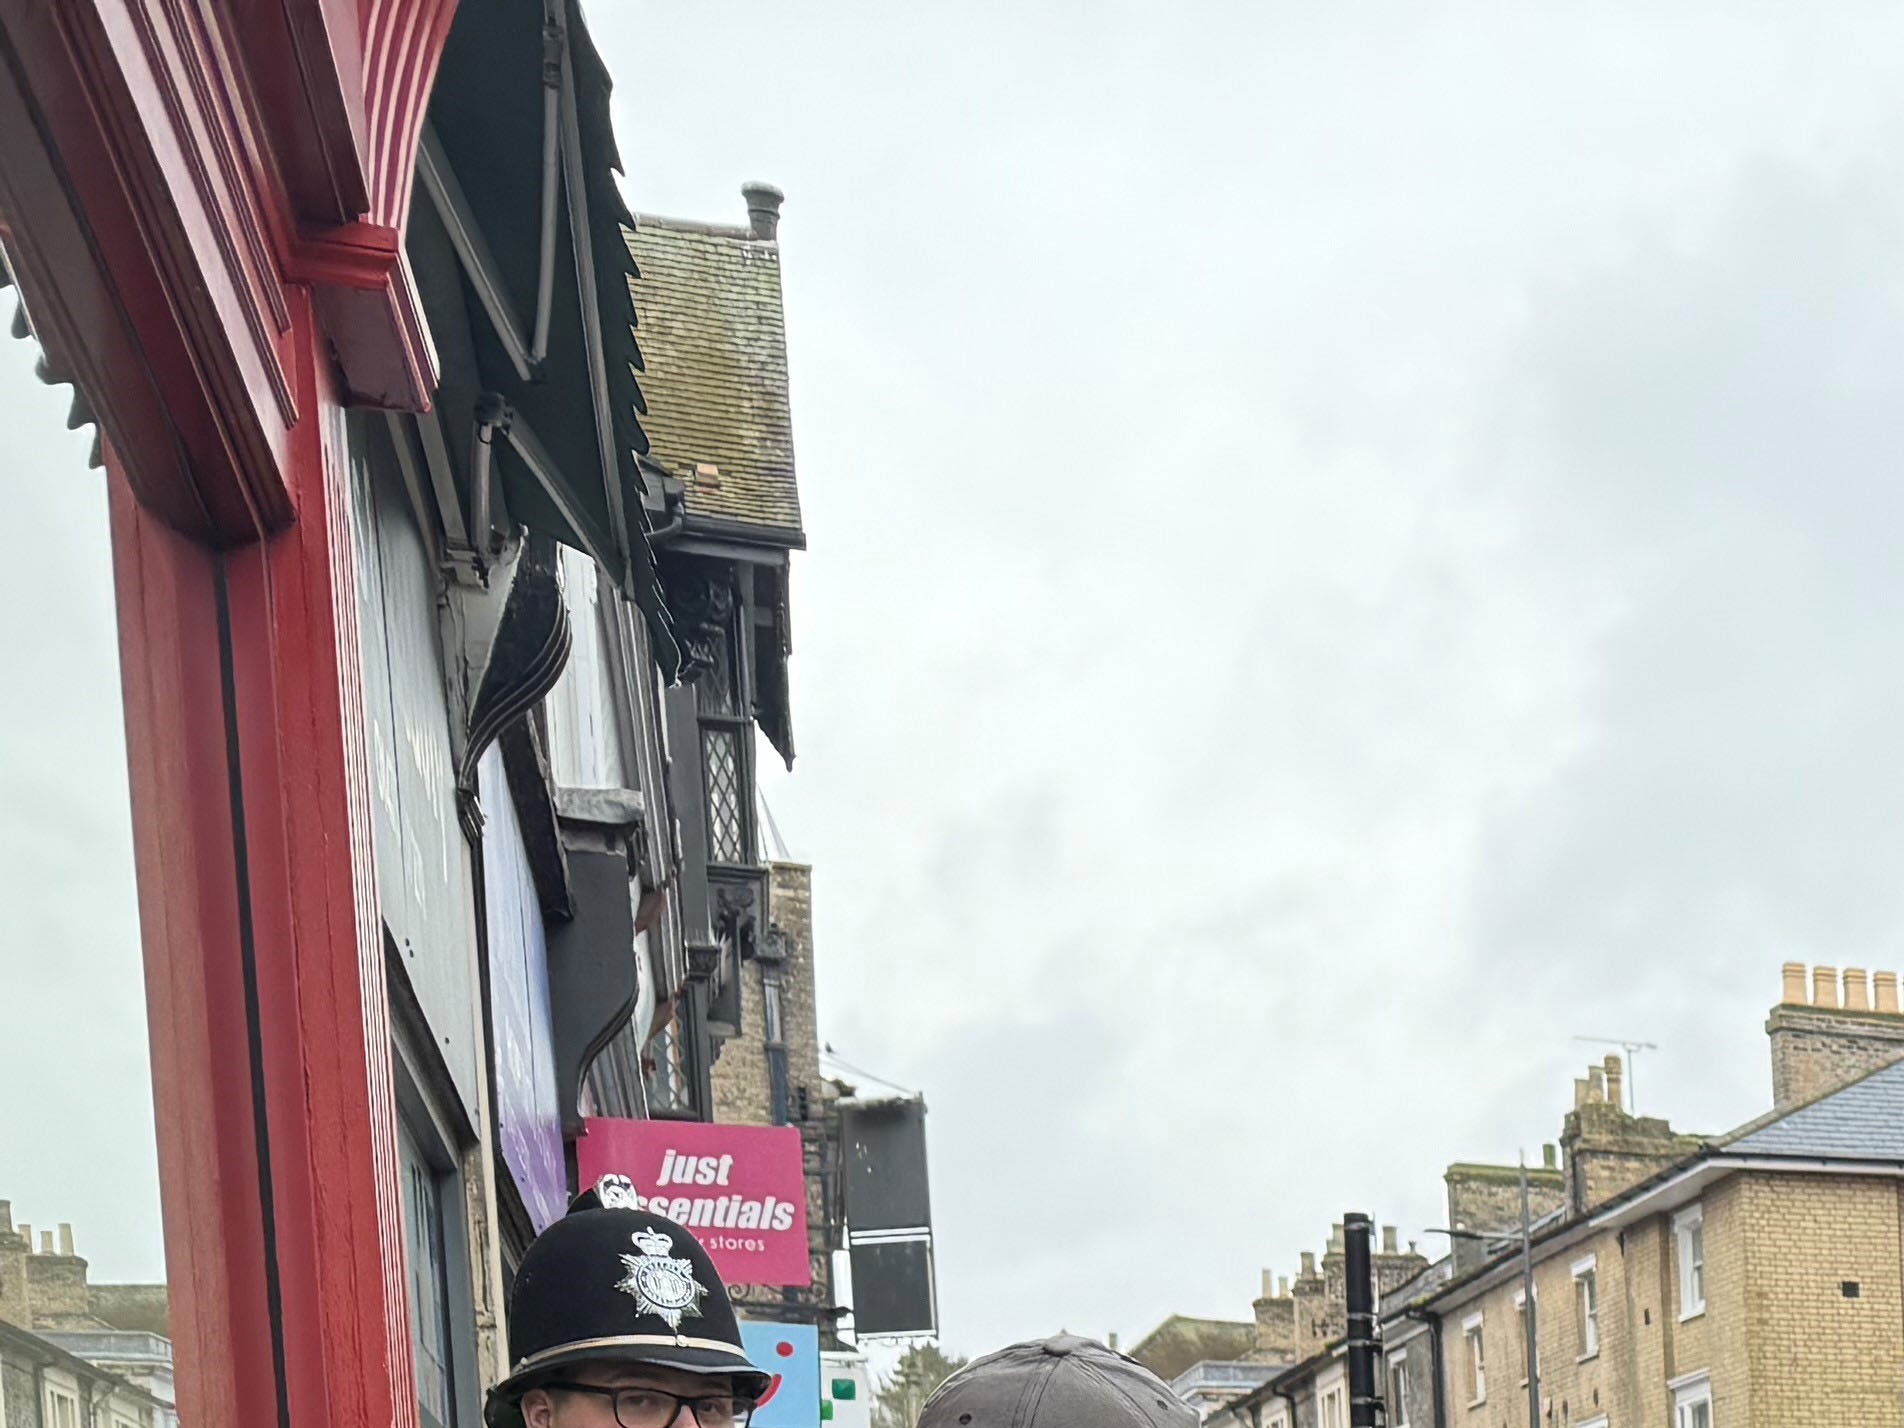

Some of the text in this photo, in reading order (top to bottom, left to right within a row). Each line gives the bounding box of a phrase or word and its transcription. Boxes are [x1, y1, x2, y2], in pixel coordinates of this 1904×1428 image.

[656, 1149, 734, 1186] just
[637, 1195, 795, 1231] sentials
[710, 1235, 765, 1252] stores
